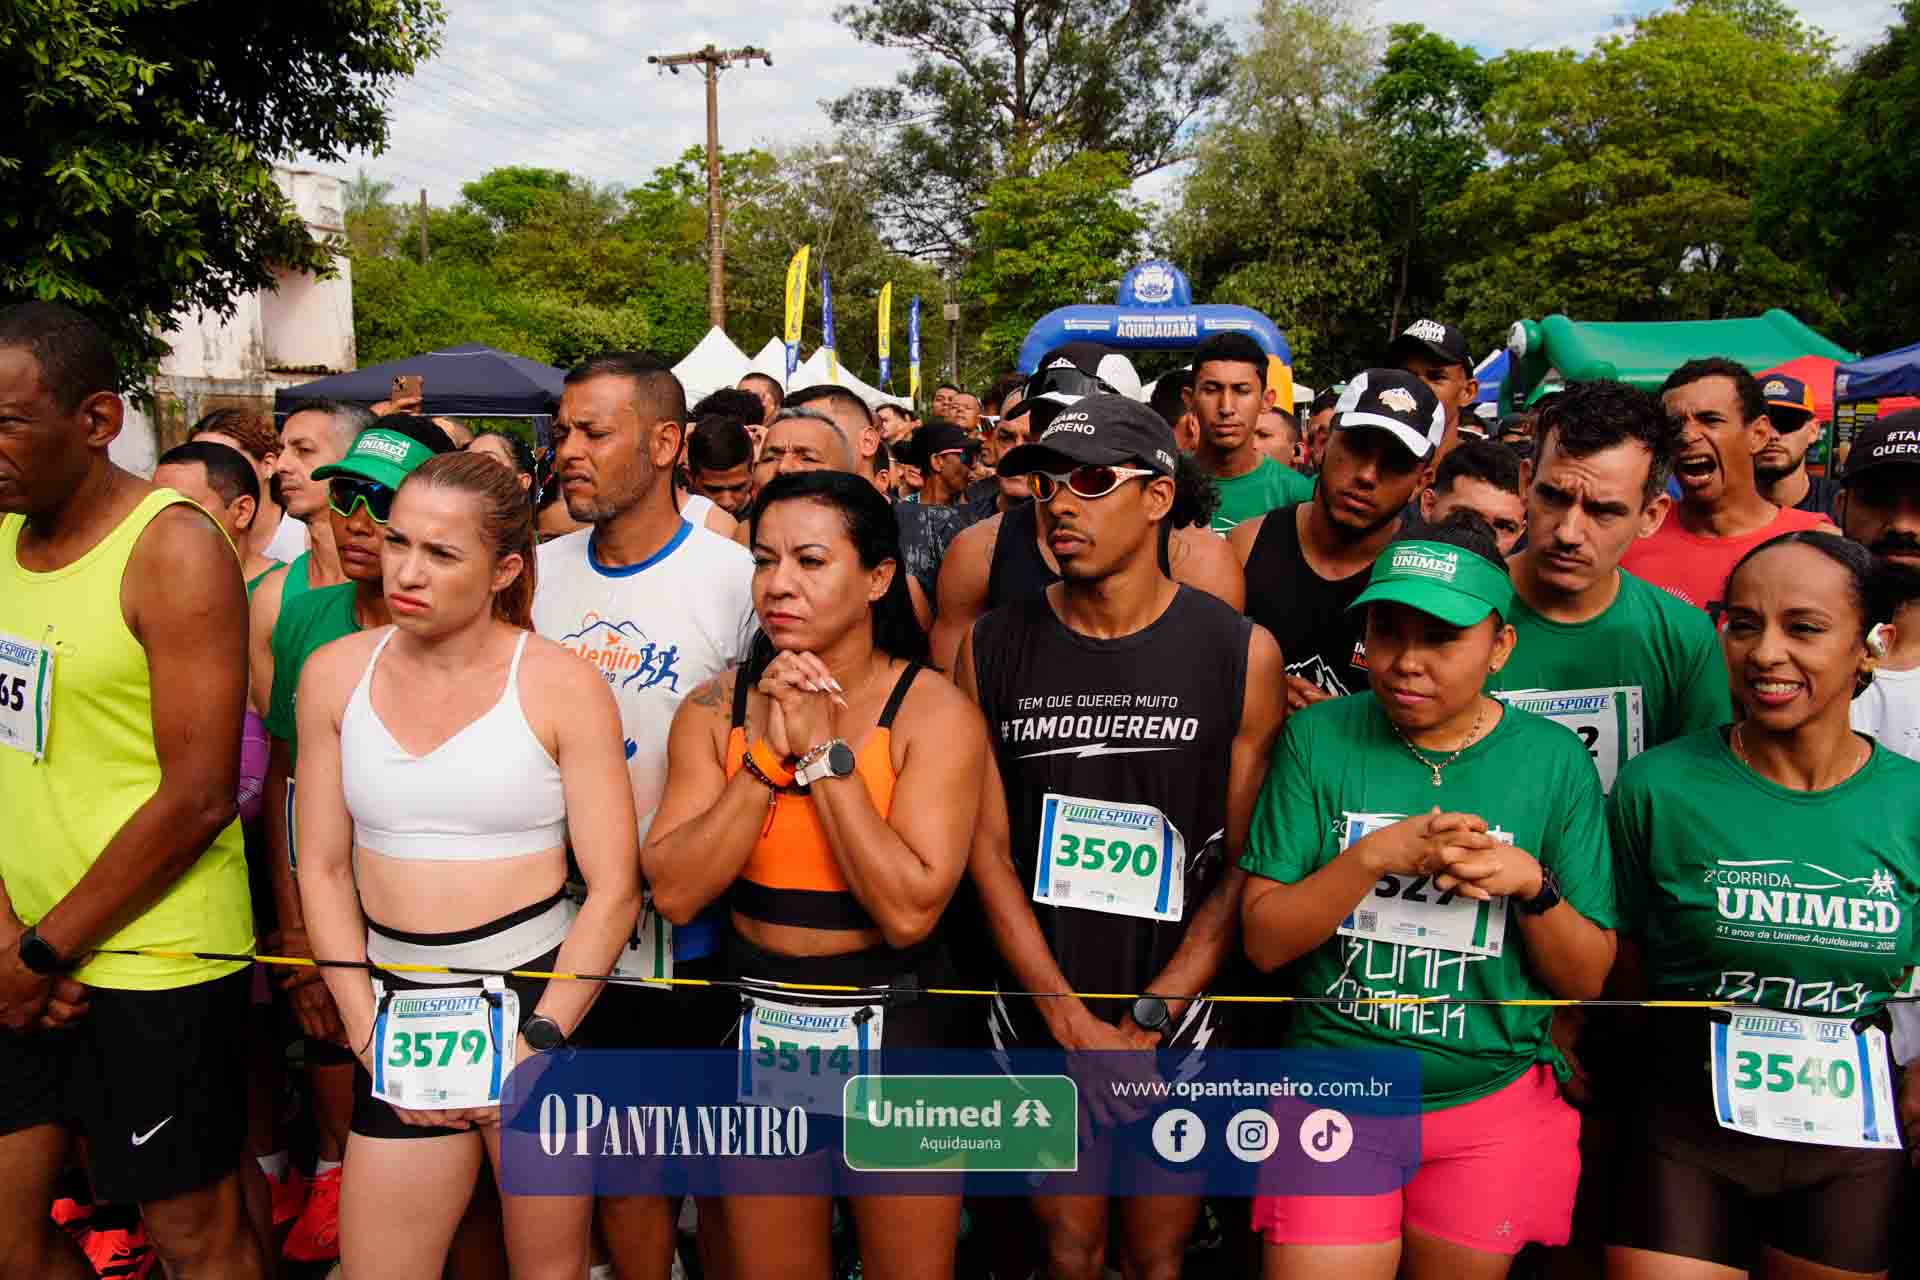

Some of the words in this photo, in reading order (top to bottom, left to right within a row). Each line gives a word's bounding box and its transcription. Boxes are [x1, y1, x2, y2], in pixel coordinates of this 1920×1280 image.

[1117, 322, 1198, 337] AQUIDAUANA
[1887, 431, 1920, 442] #TA
[358, 440, 408, 457] UNIMED
[1872, 444, 1920, 457] QUER
[1393, 556, 1456, 573] UNIMED
[1017, 697, 1043, 710] TEM
[1047, 695, 1073, 708] QUE
[1077, 695, 1131, 707] QUERER
[1135, 696, 1178, 709] MUITO
[1001, 716, 1199, 742] #TAMOQUERENO
[1062, 804, 1158, 826] FUNDESPORTE
[1056, 834, 1158, 877] 3590
[1716, 887, 1900, 933] UNIMED
[1716, 925, 1728, 935] 41
[1731, 929, 1755, 937] anos
[1757, 929, 1770, 938] da
[1773, 931, 1810, 942] Unimed
[1812, 934, 1868, 949] Aquidauana
[1735, 1016, 1848, 1038] FUNDESRTE
[388, 1030, 487, 1068] 3579
[756, 1036, 851, 1074] 3514
[1734, 1051, 1855, 1098] 3540
